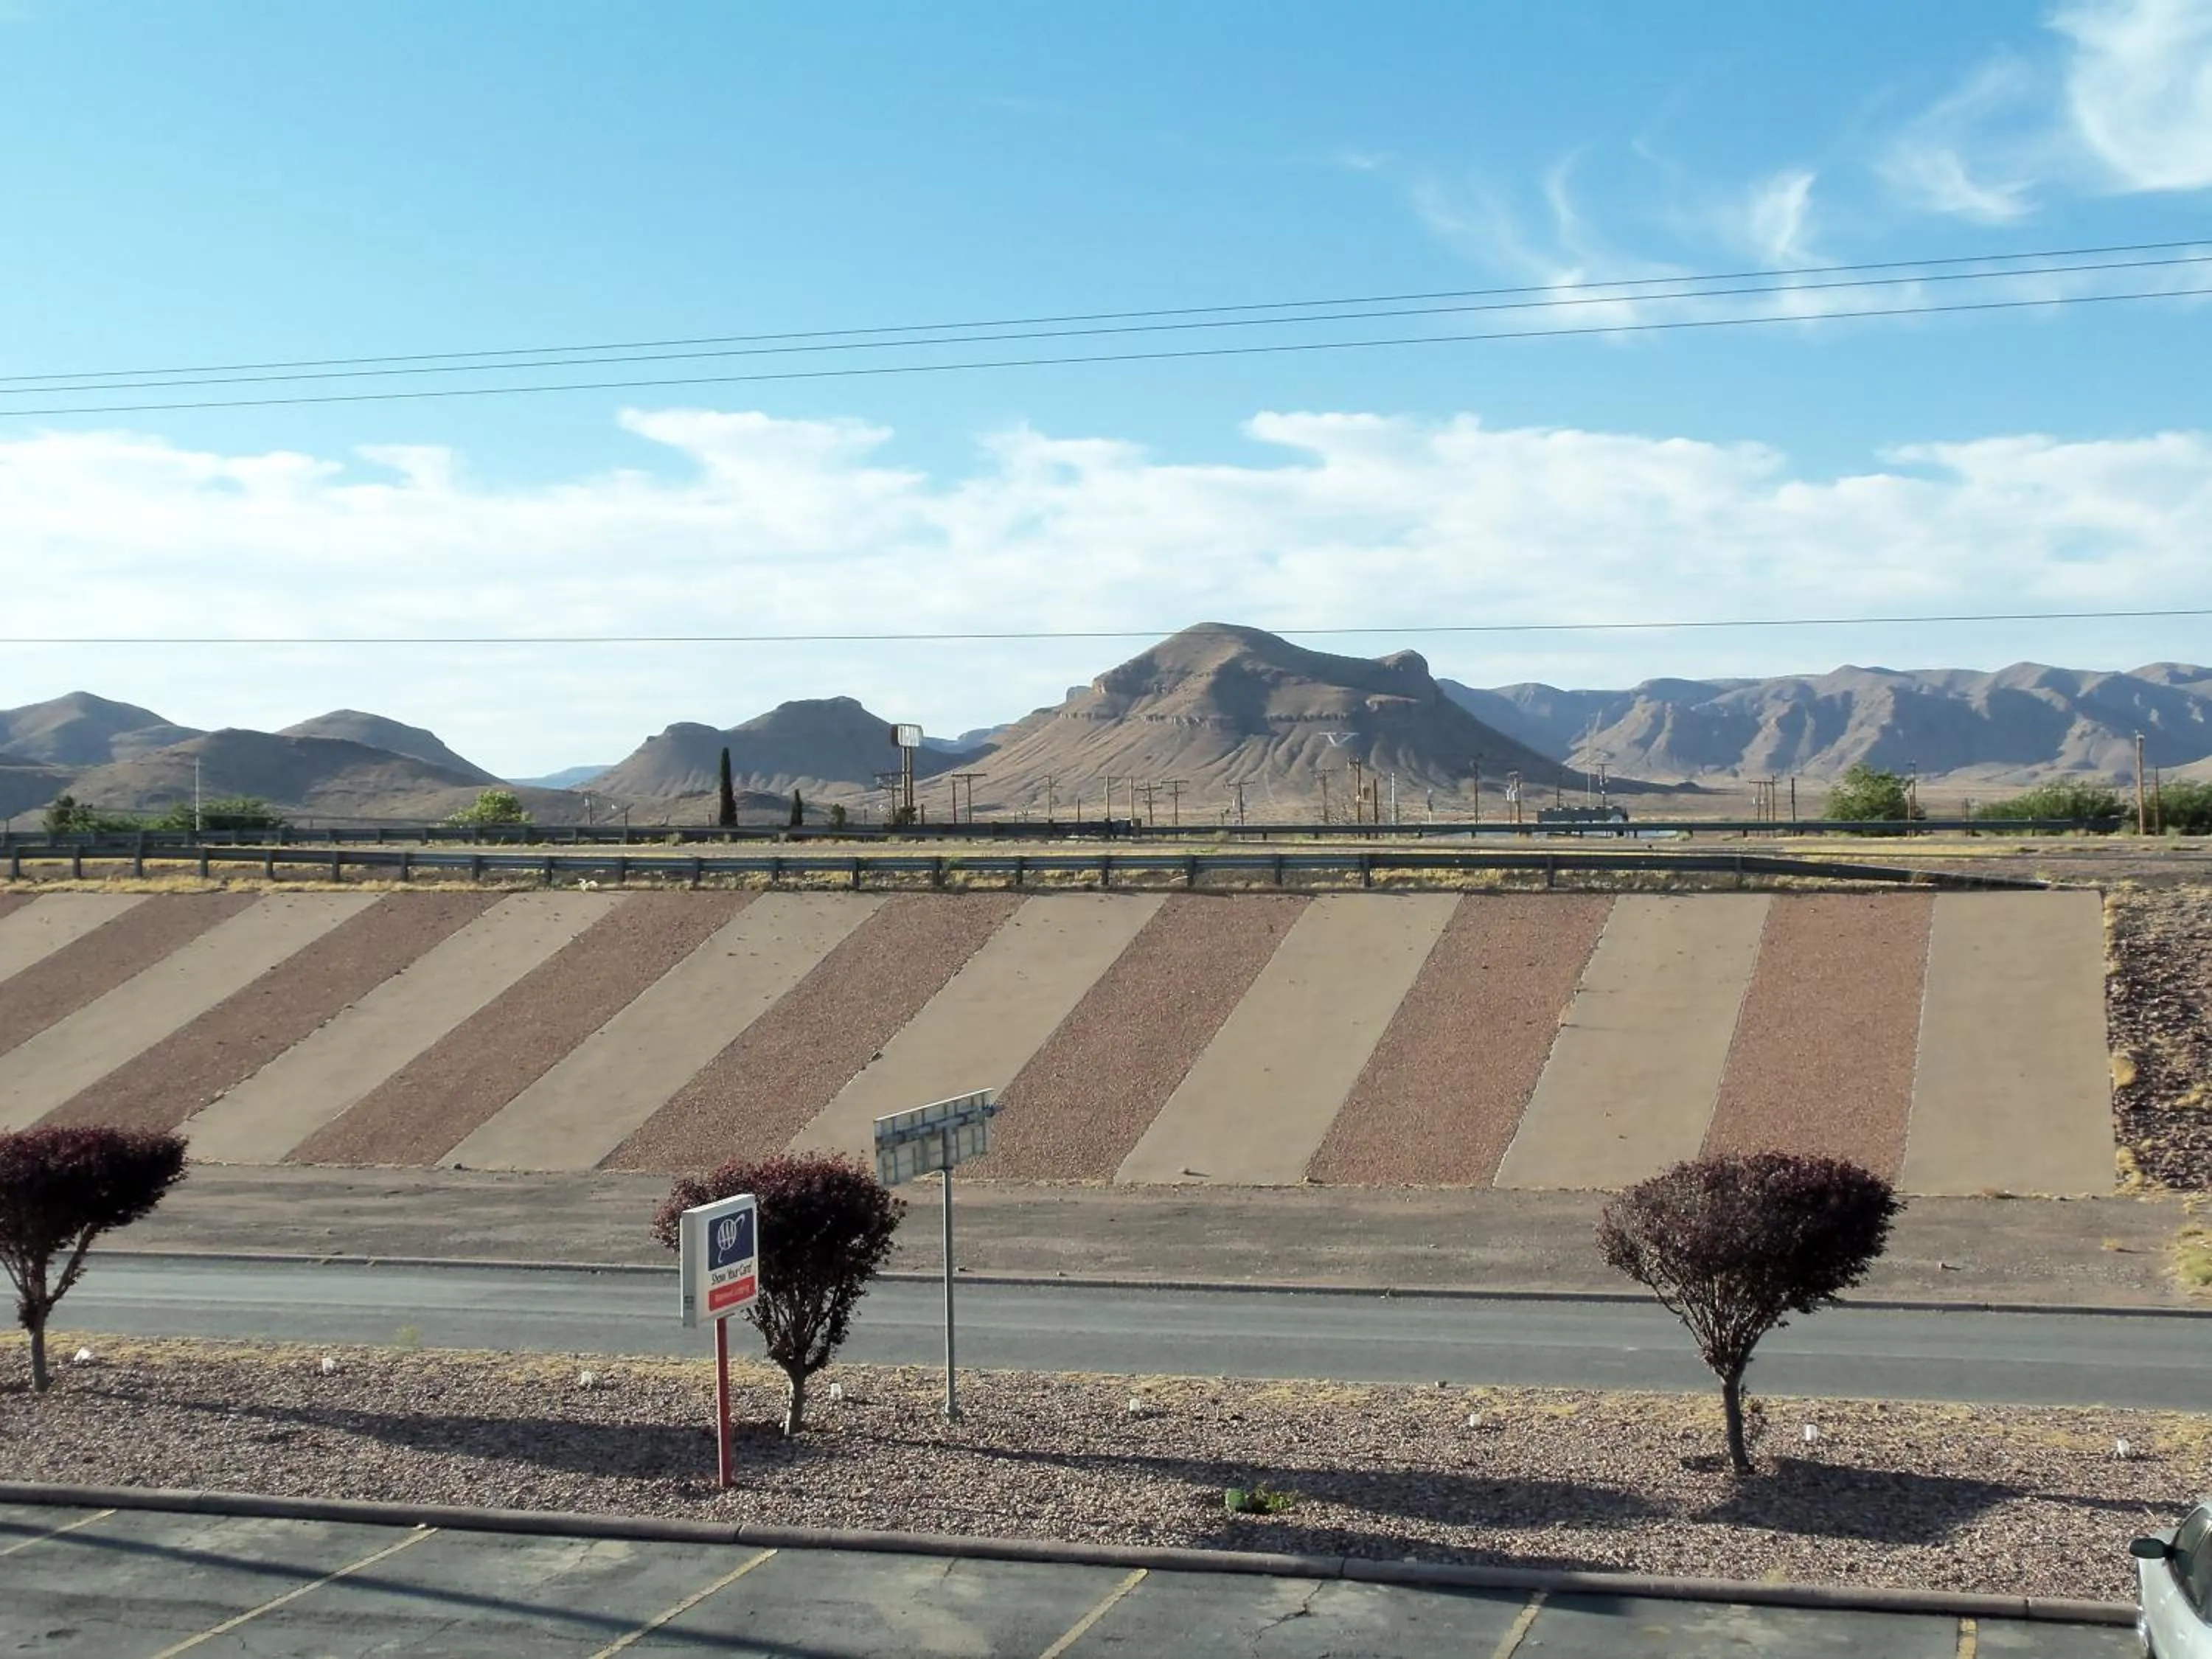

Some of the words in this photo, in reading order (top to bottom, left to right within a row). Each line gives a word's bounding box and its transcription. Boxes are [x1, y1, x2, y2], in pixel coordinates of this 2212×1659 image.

[712, 1273, 726, 1284] Show
[727, 1267, 738, 1279] Your
[739, 1261, 752, 1276] Card
